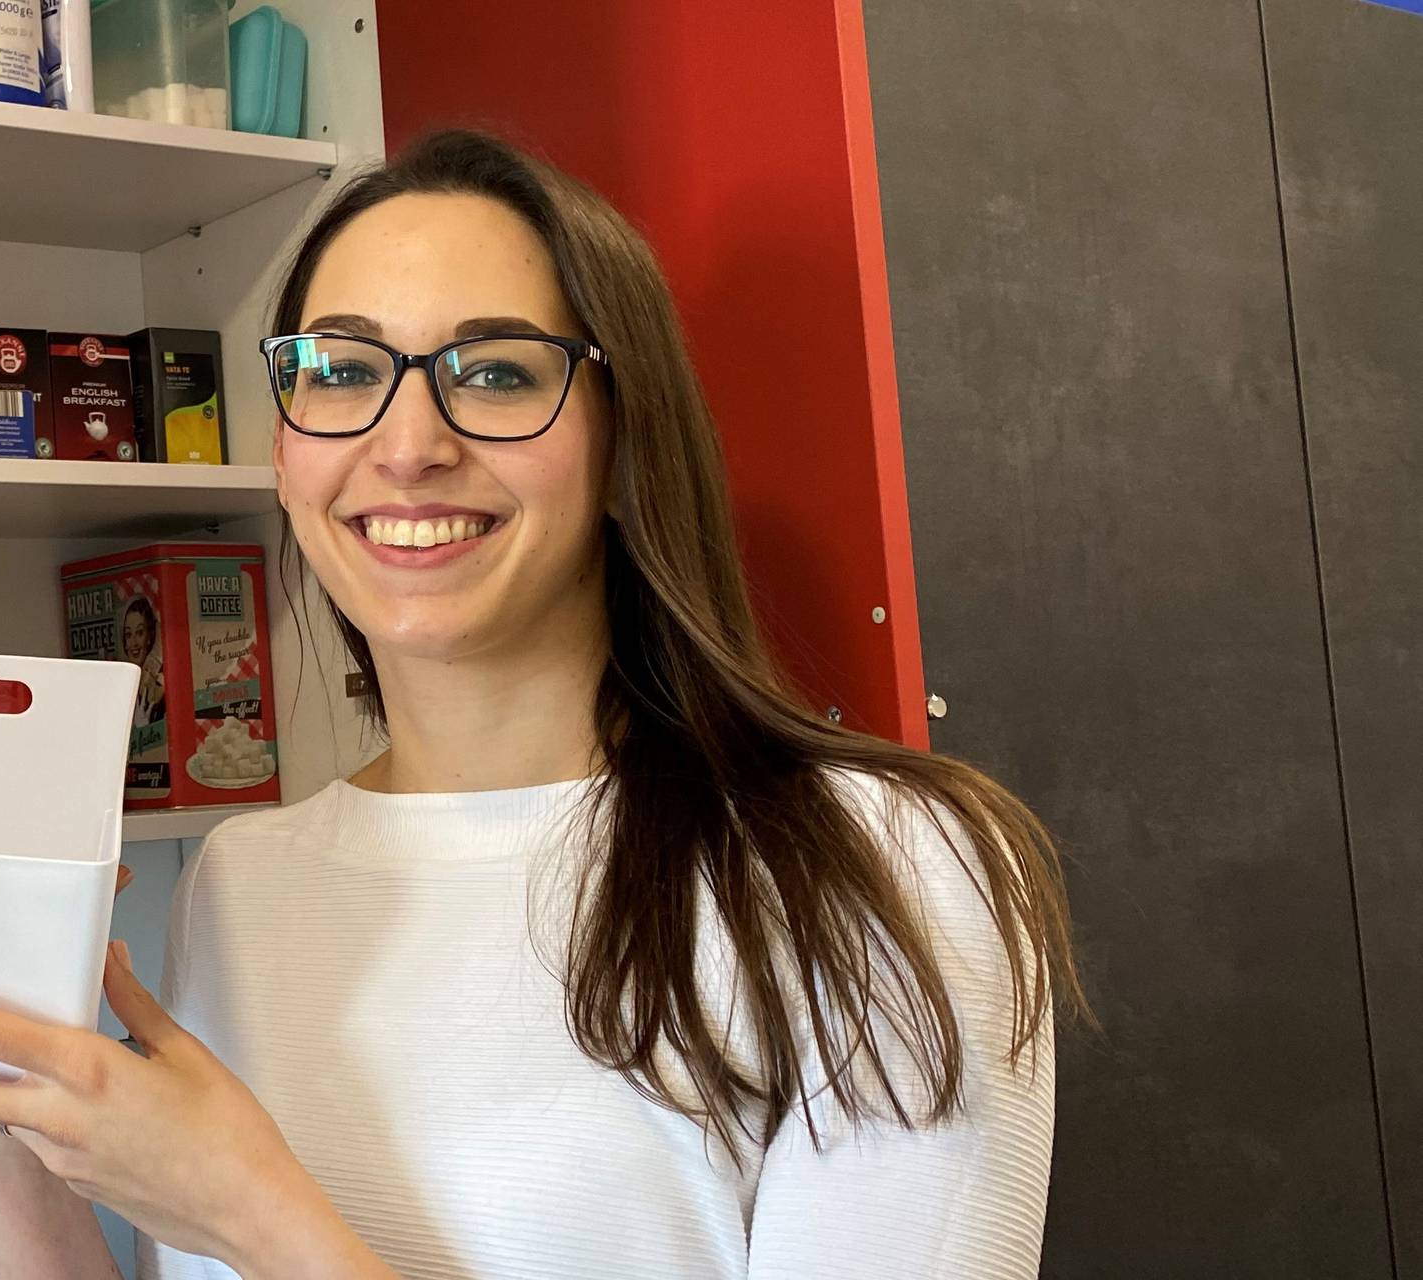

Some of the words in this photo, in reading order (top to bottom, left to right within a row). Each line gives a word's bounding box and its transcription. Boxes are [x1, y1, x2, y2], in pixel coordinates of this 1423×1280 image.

[71, 387, 118, 398] ENGLISH
[63, 396, 126, 407] BREAKFAST
[199, 575, 229, 593] HAVE
[231, 575, 240, 591] A
[68, 591, 102, 621] HAVE
[104, 589, 113, 614] A
[201, 597, 242, 614] COFFEE
[72, 623, 115, 652] COFFEE
[196, 635, 206, 654] If
[207, 638, 222, 654] you
[223, 627, 250, 645] double
[214, 649, 226, 664] the
[228, 648, 250, 664] sugar
